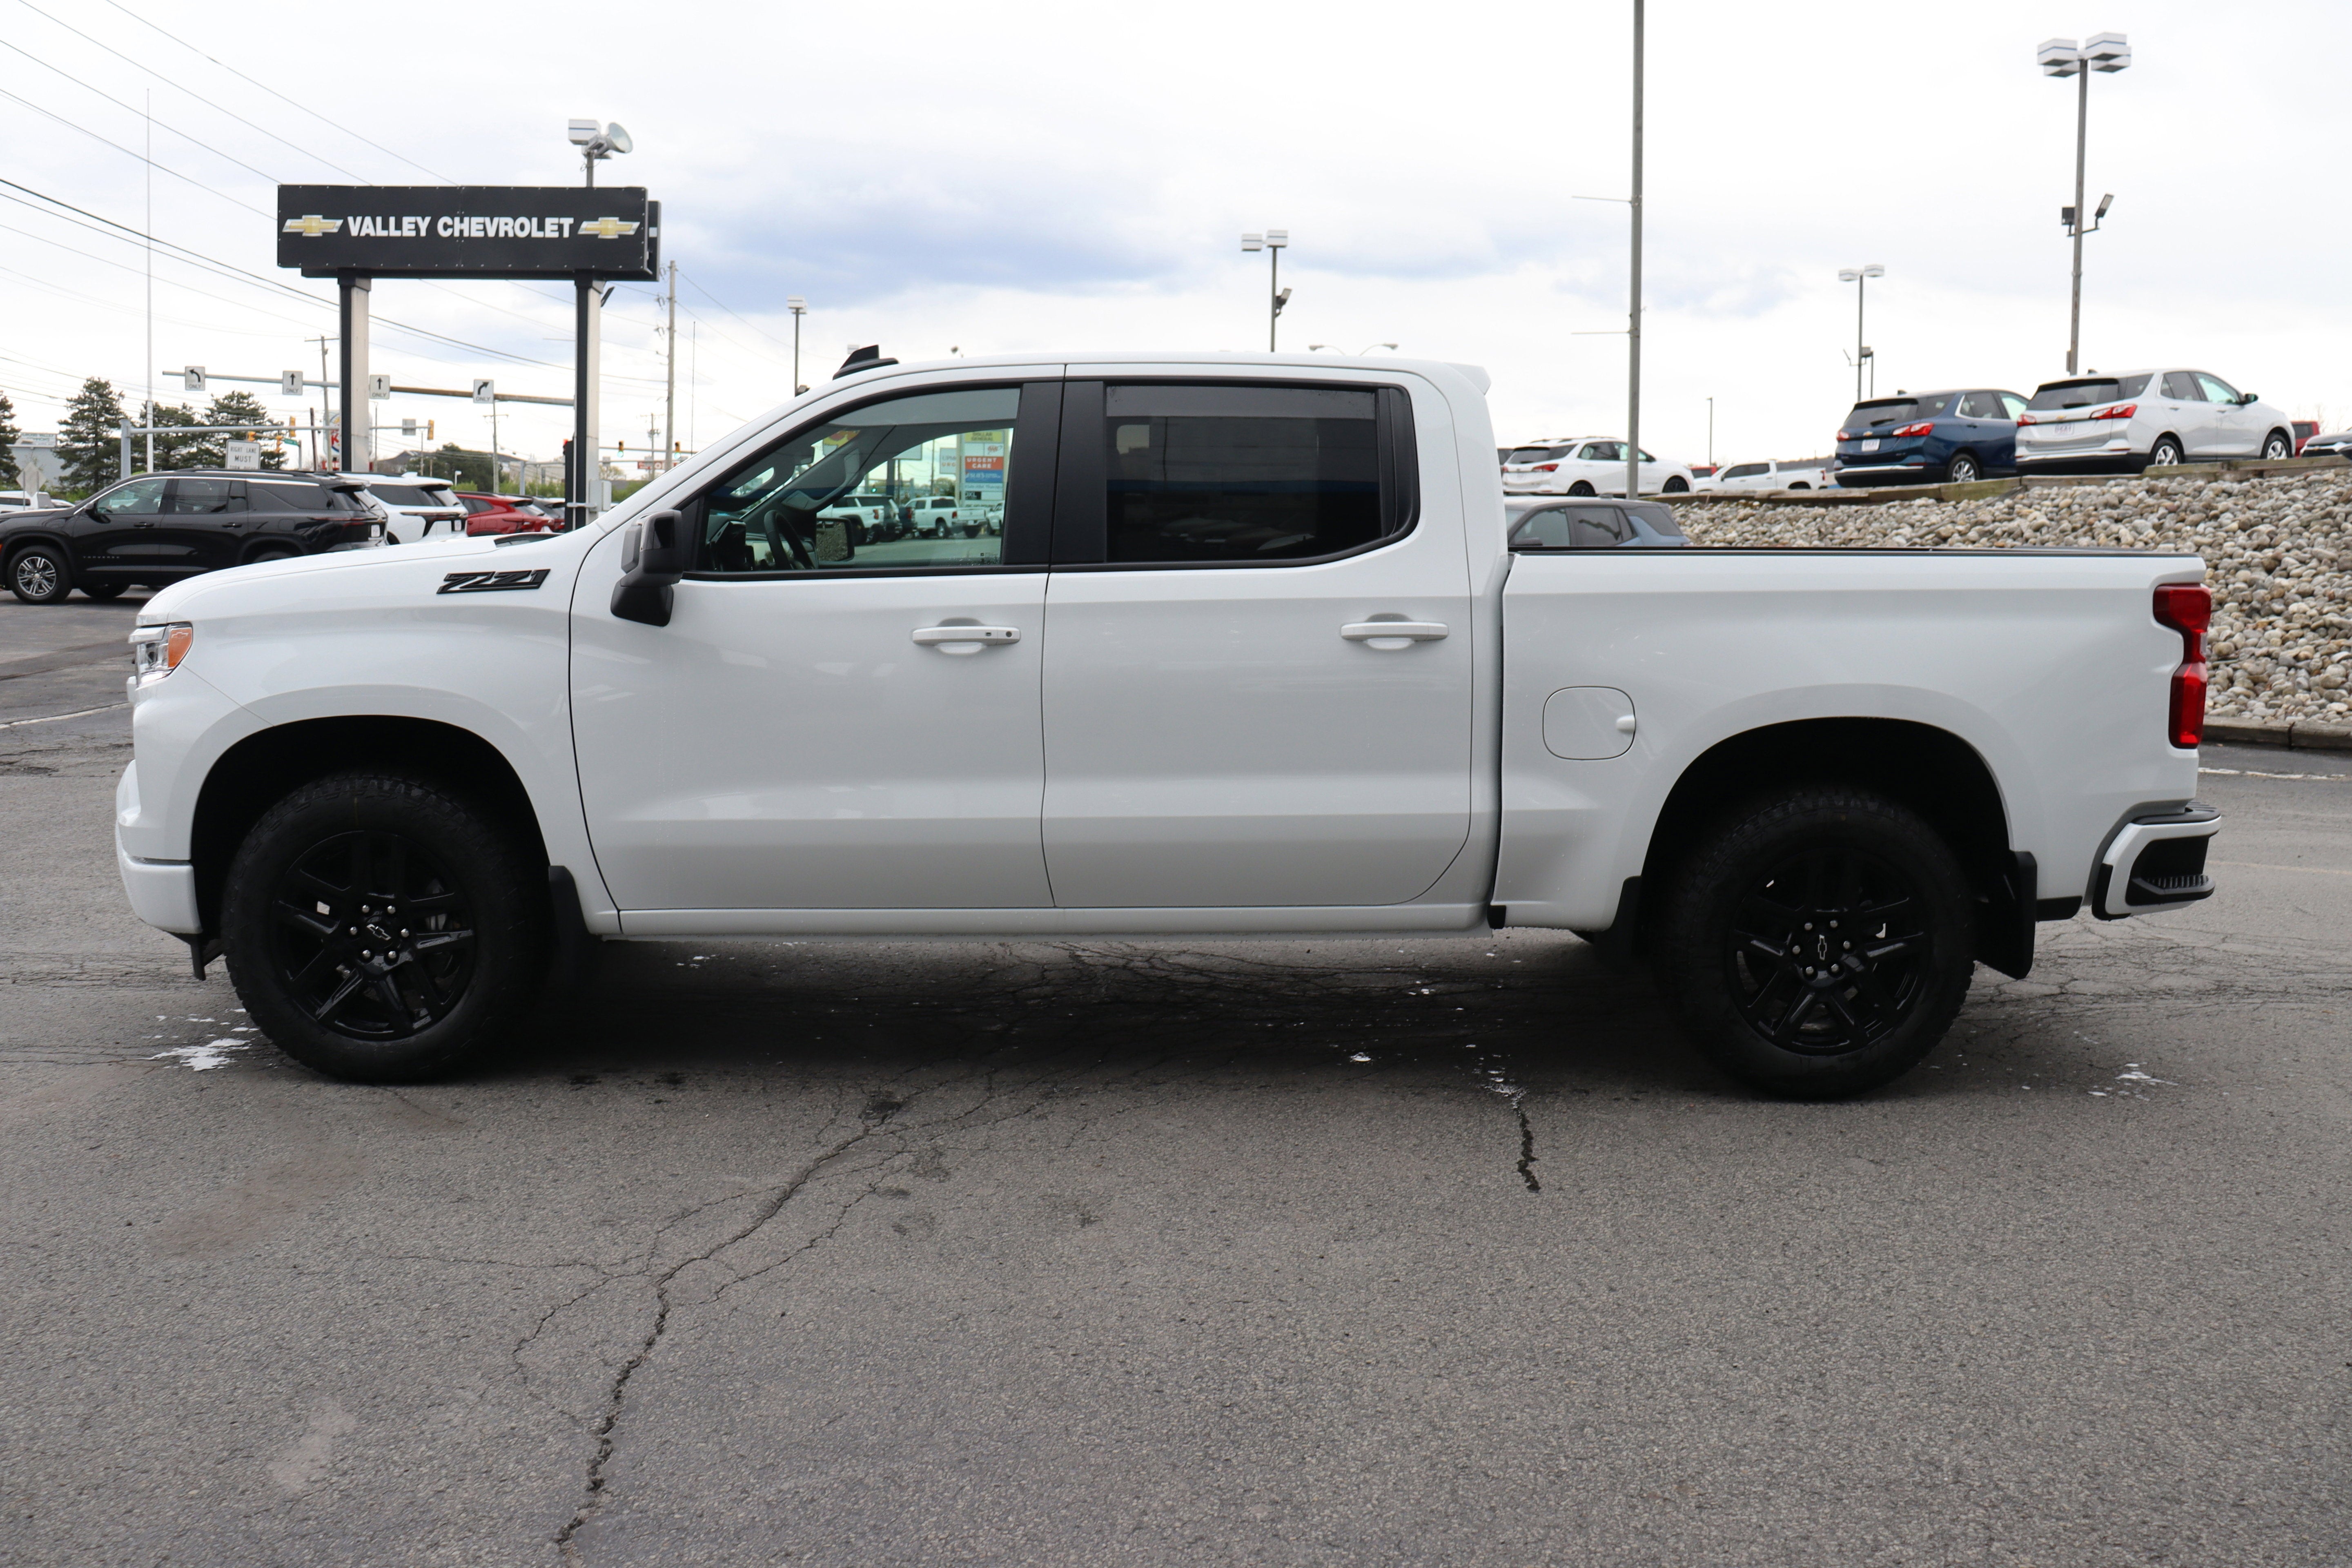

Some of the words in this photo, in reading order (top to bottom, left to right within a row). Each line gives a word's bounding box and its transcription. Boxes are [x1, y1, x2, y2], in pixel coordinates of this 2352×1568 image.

[347, 216, 431, 236] VALLEY
[437, 216, 574, 238] CHEVROLET
[436, 568, 551, 594] Z71
